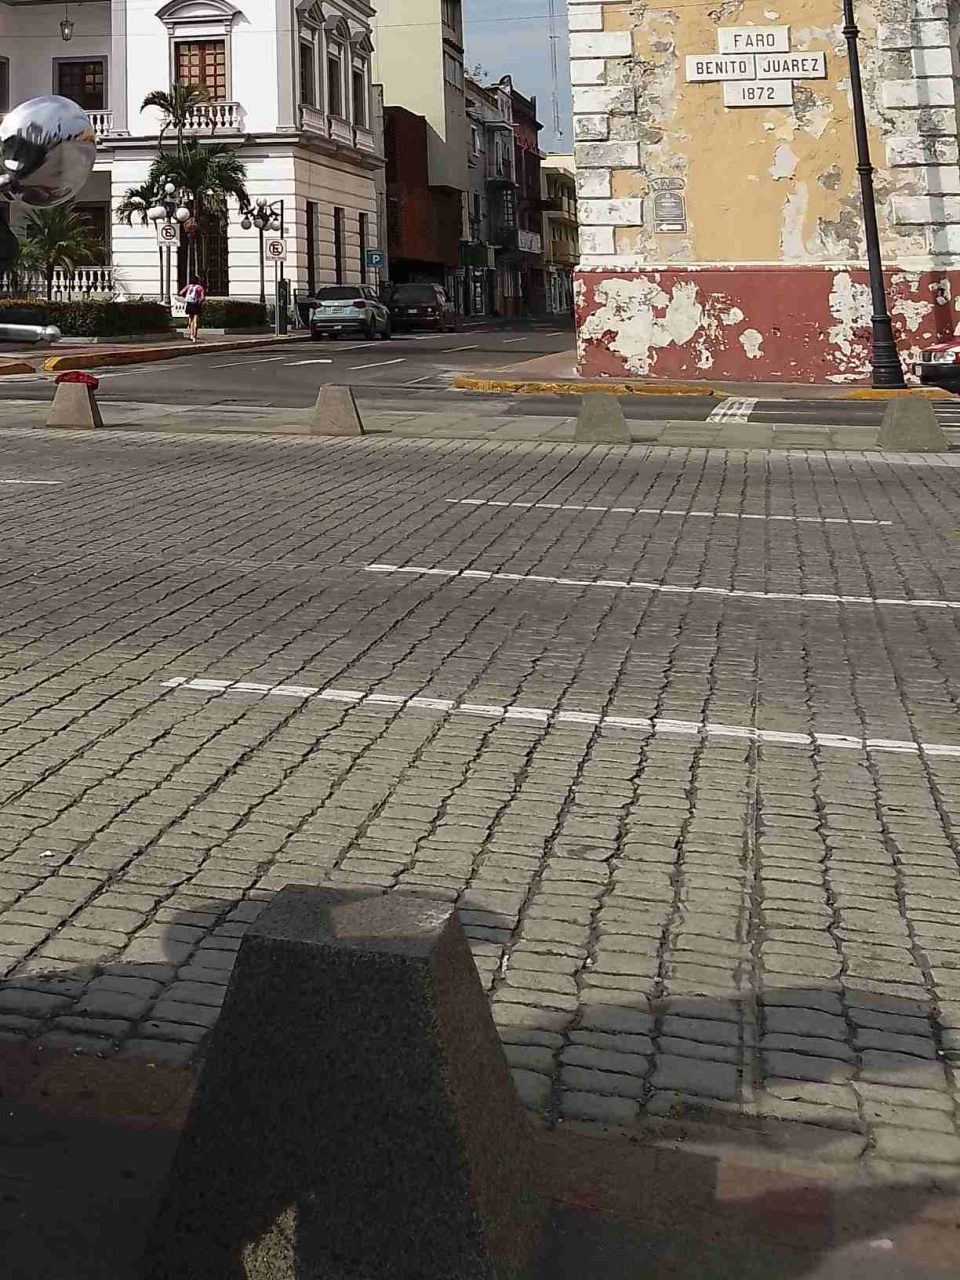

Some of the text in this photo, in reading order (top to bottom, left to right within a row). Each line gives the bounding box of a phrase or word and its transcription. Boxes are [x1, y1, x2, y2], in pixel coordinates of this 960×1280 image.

[733, 33, 776, 48] FARO
[696, 58, 819, 75] BENITO JUAREZ
[742, 87, 775, 100] 1872
[372, 254, 380, 264] P
